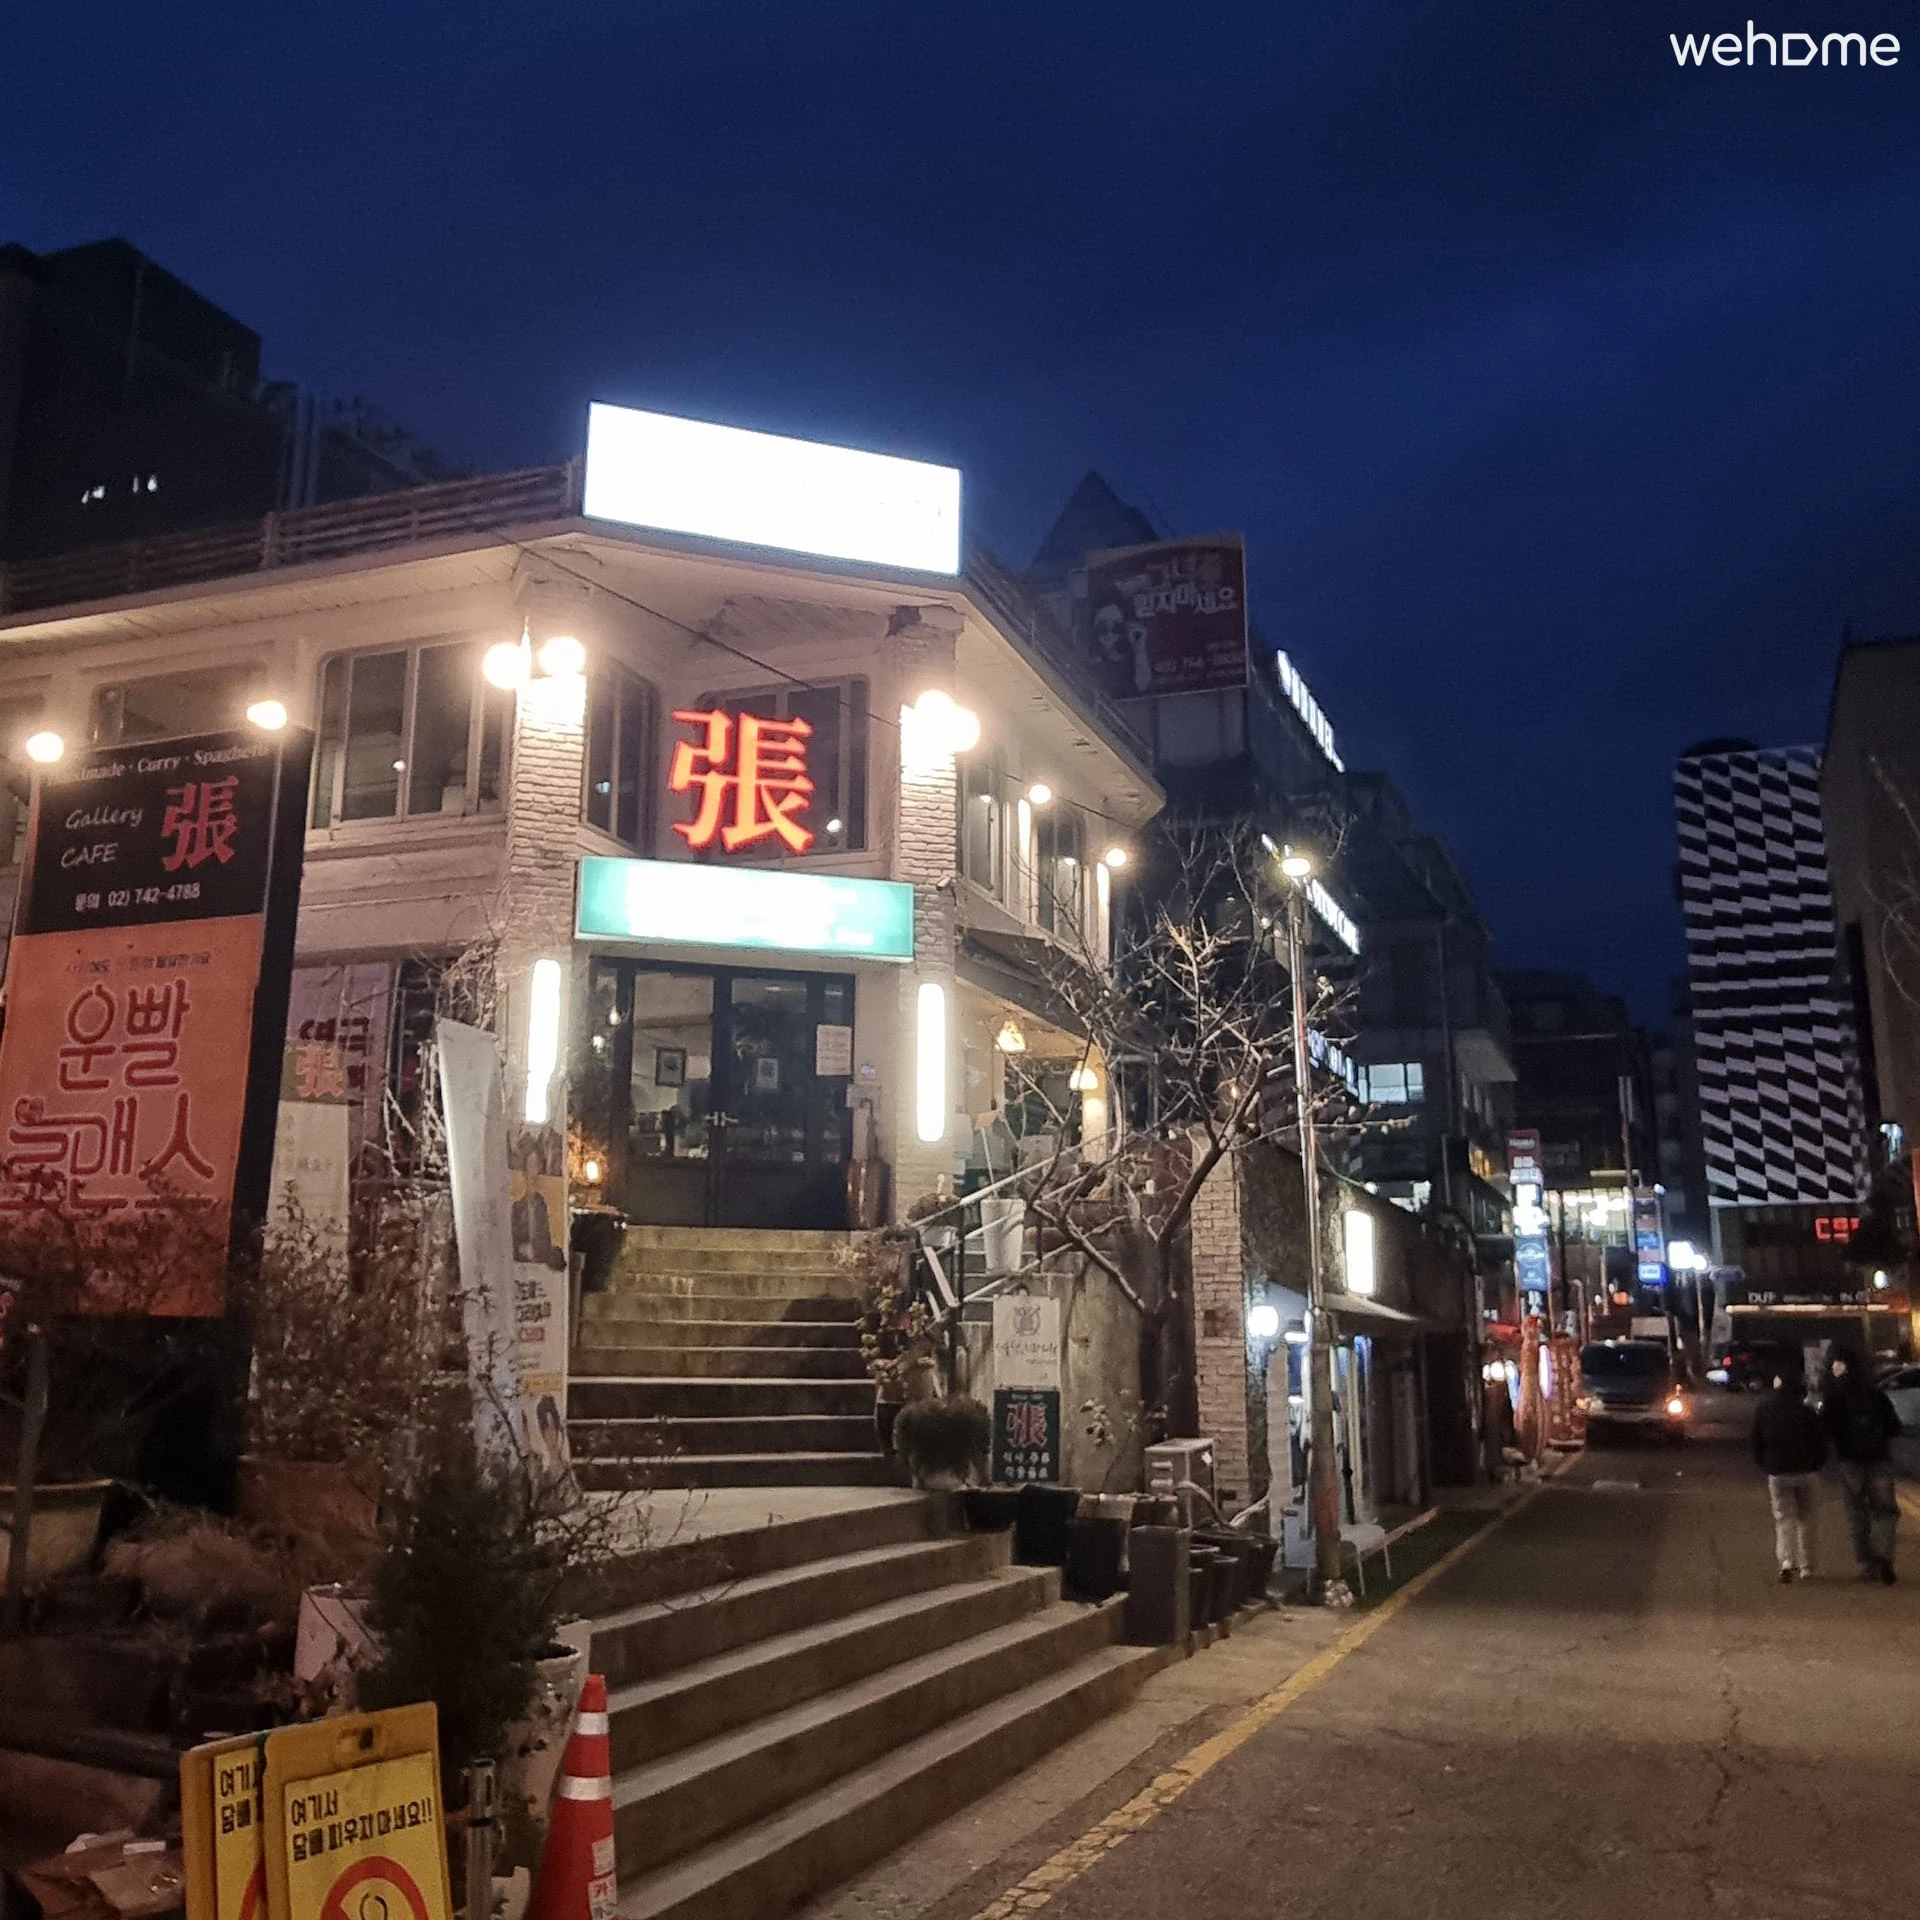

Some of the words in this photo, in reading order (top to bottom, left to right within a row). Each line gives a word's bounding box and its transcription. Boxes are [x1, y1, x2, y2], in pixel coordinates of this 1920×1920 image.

[137, 754, 182, 773] Curry
[668, 708, 816, 856] 張
[64, 805, 144, 830] Gallery
[161, 775, 240, 873] 張
[60, 841, 119, 869] CAFE
[107, 889, 130, 908] 02)
[58, 977, 191, 1090] 운빨
[291, 1789, 339, 1827] 여기서
[328, 1812, 374, 1851] 피우지
